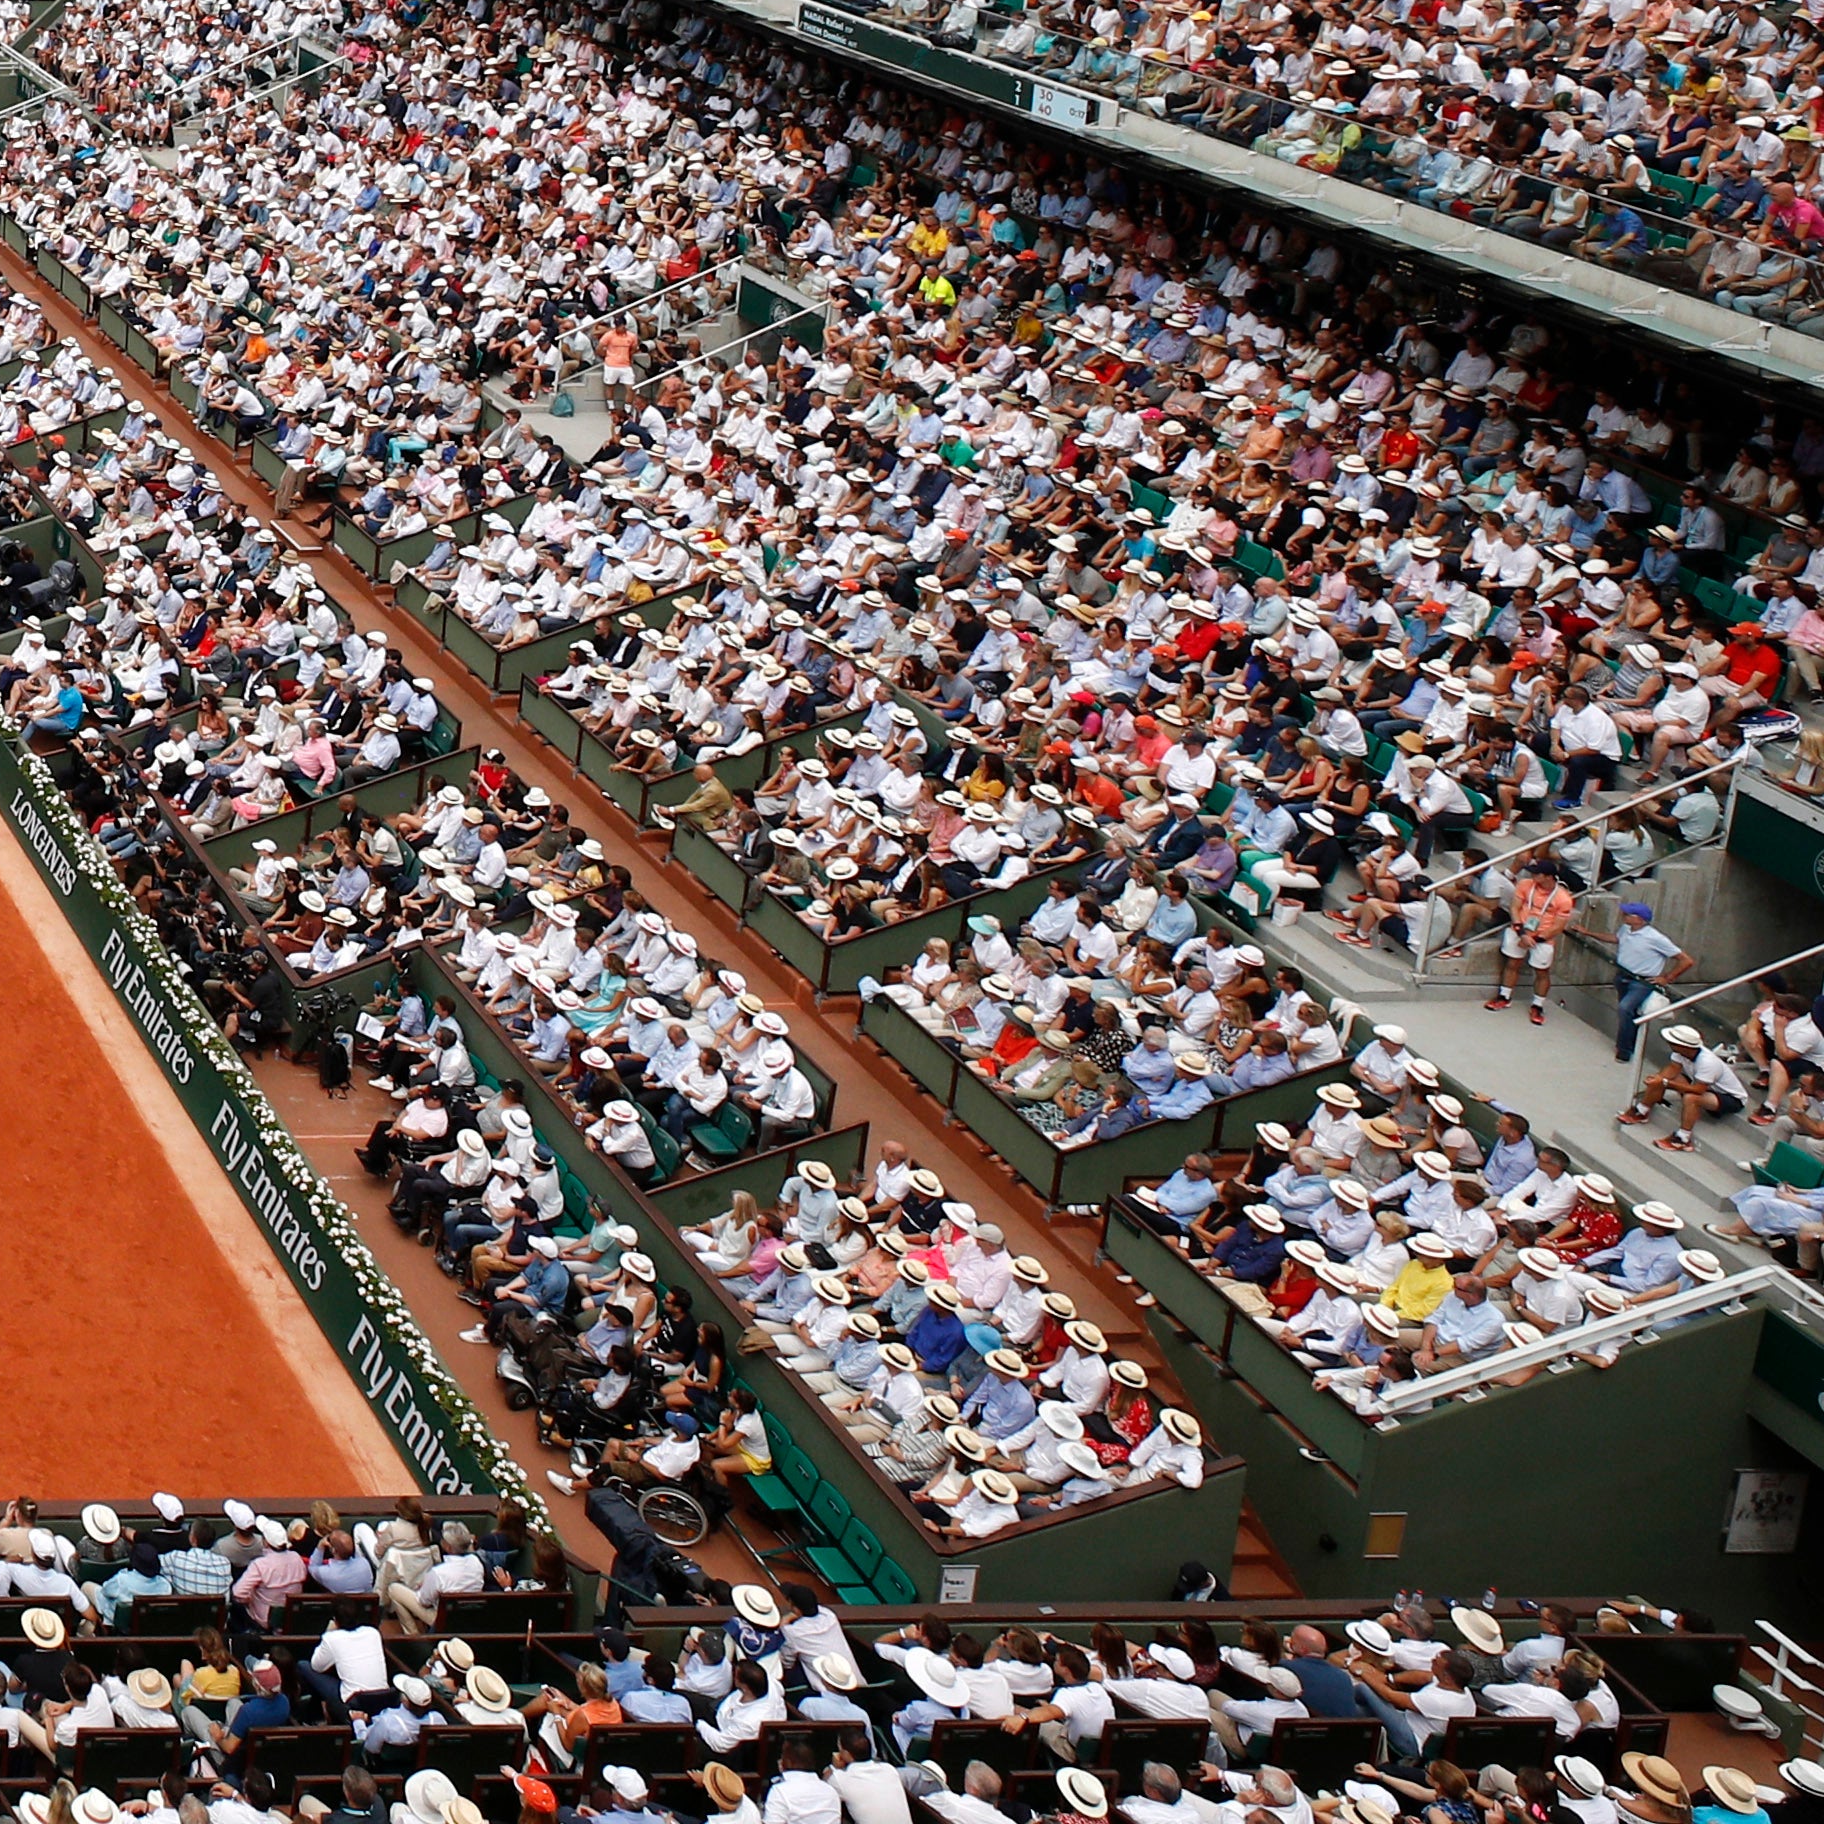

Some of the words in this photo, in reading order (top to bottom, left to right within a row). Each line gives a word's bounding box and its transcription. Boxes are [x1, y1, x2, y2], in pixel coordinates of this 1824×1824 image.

[1014, 81, 1022, 92] 2
[1014, 95, 1020, 106] 1
[1038, 103, 1052, 116] 40
[1039, 89, 1053, 102] 30
[9, 786, 77, 897] LONGINES
[101, 928, 132, 990] Fly
[123, 964, 195, 1085] Emirates
[210, 1099, 248, 1173] Fly
[238, 1138, 327, 1291] Emirates
[345, 1313, 394, 1401] Fly
